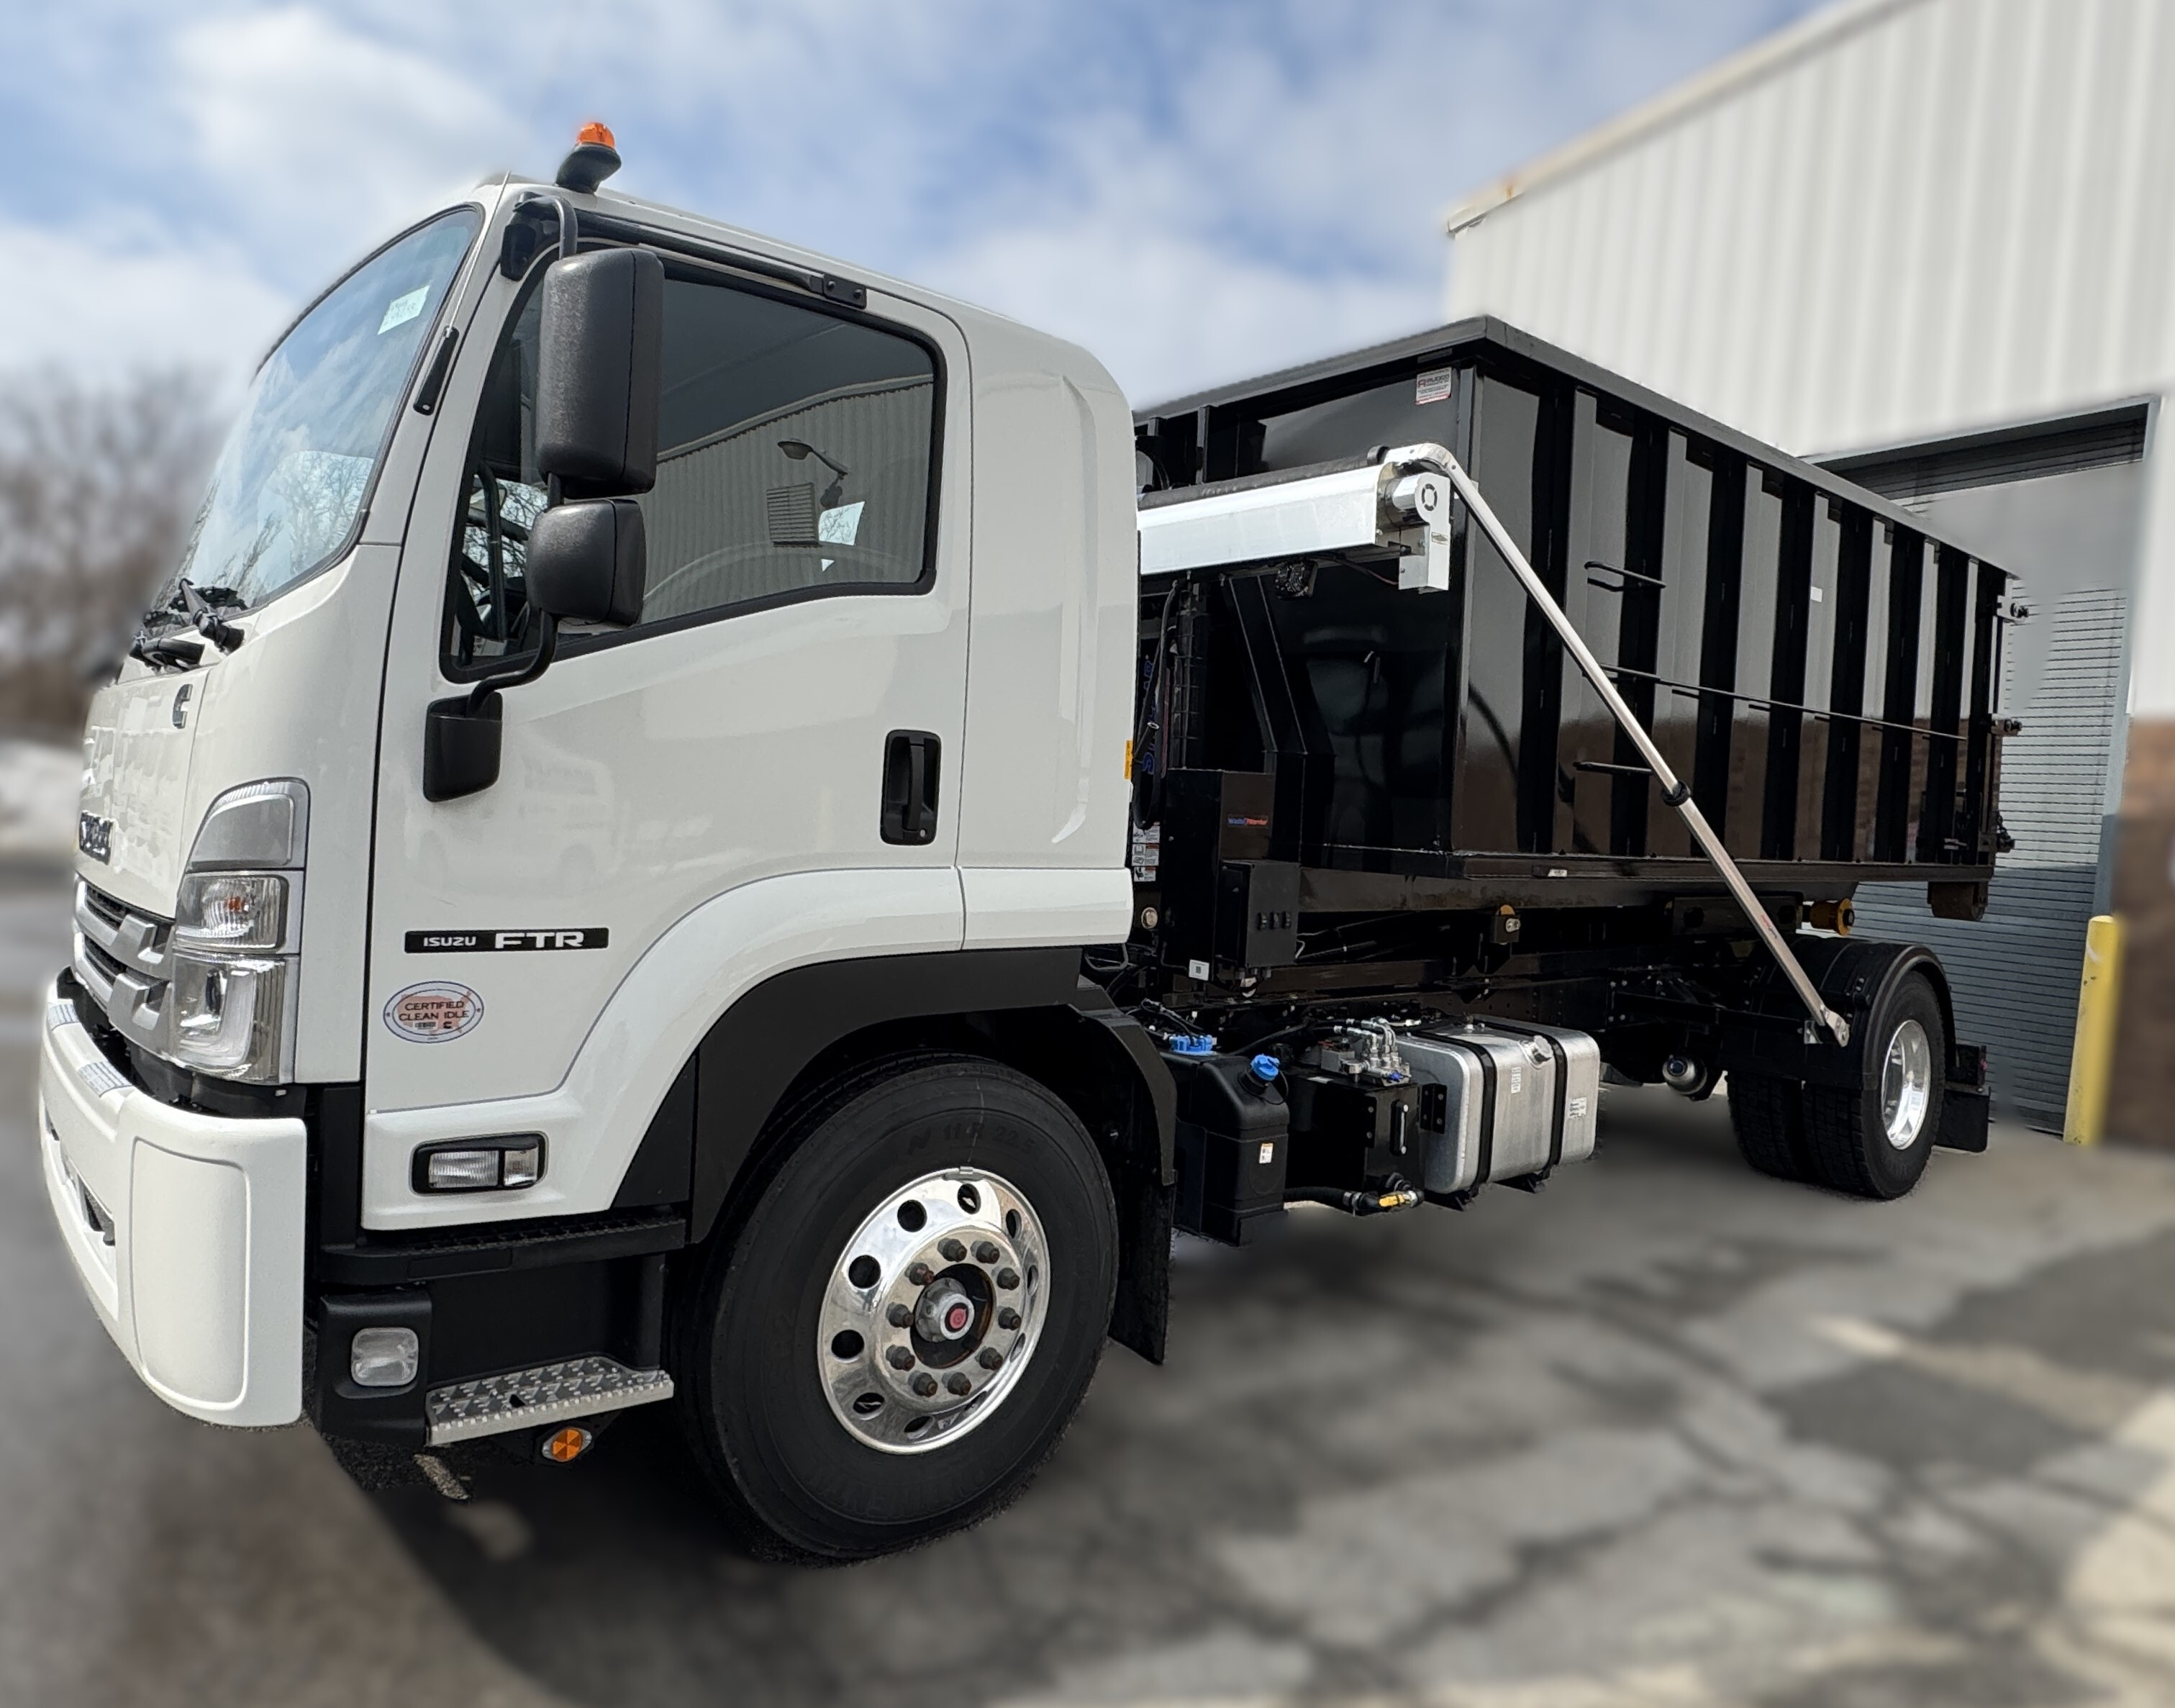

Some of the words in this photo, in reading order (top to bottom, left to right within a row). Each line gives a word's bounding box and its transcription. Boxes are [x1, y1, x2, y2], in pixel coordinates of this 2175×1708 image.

[423, 936, 476, 947] ISUZU
[494, 931, 584, 949] FTR
[404, 1001, 465, 1011] CERTIFIED
[398, 1012, 439, 1021] CLEAN
[444, 1010, 470, 1019] IDLE
